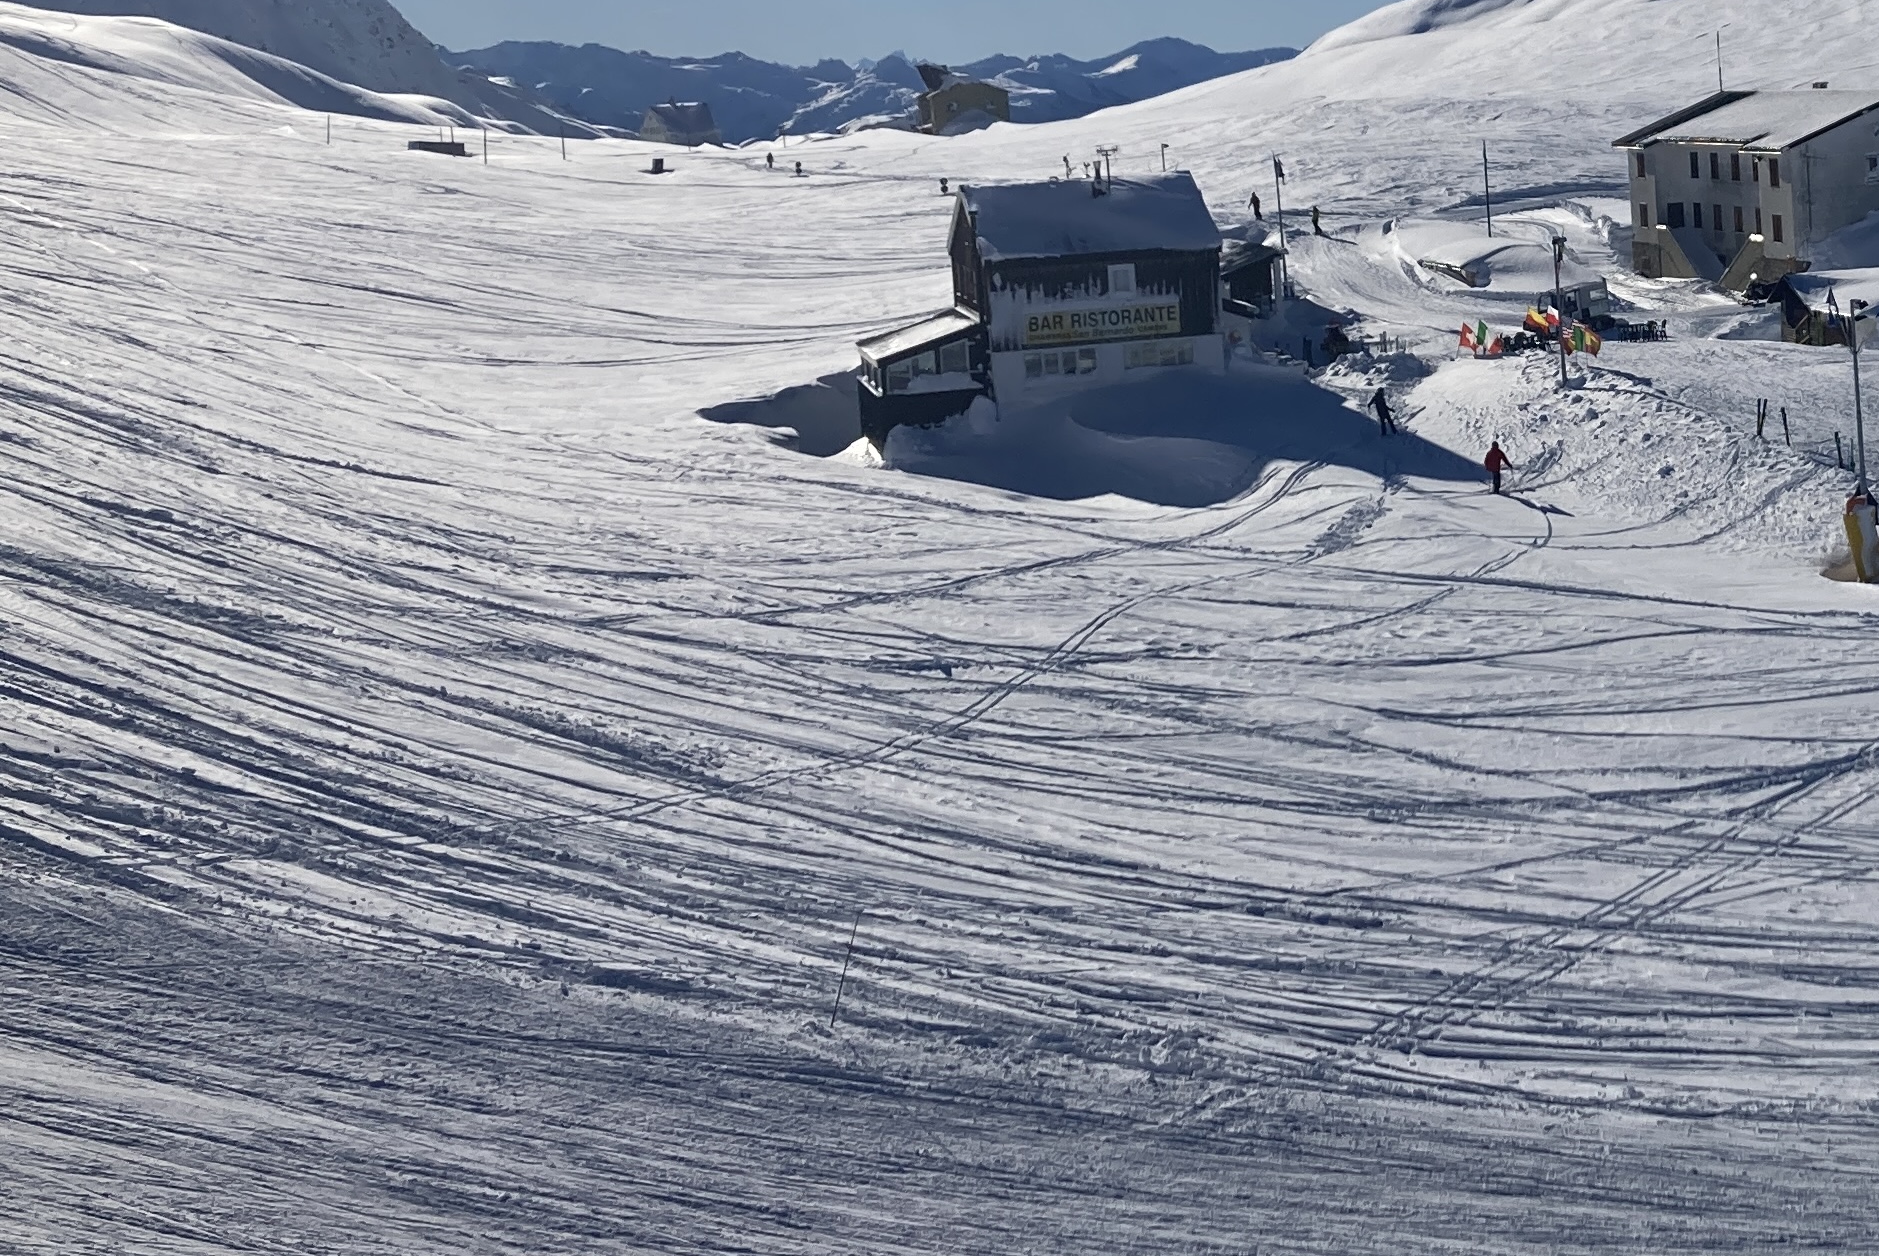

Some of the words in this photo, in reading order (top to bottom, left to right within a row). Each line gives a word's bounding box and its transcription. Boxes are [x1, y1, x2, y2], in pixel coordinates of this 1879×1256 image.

[1028, 315, 1063, 332] BAR
[1071, 305, 1176, 328] RISTORANTE
[1092, 326, 1134, 337] Bernardo
